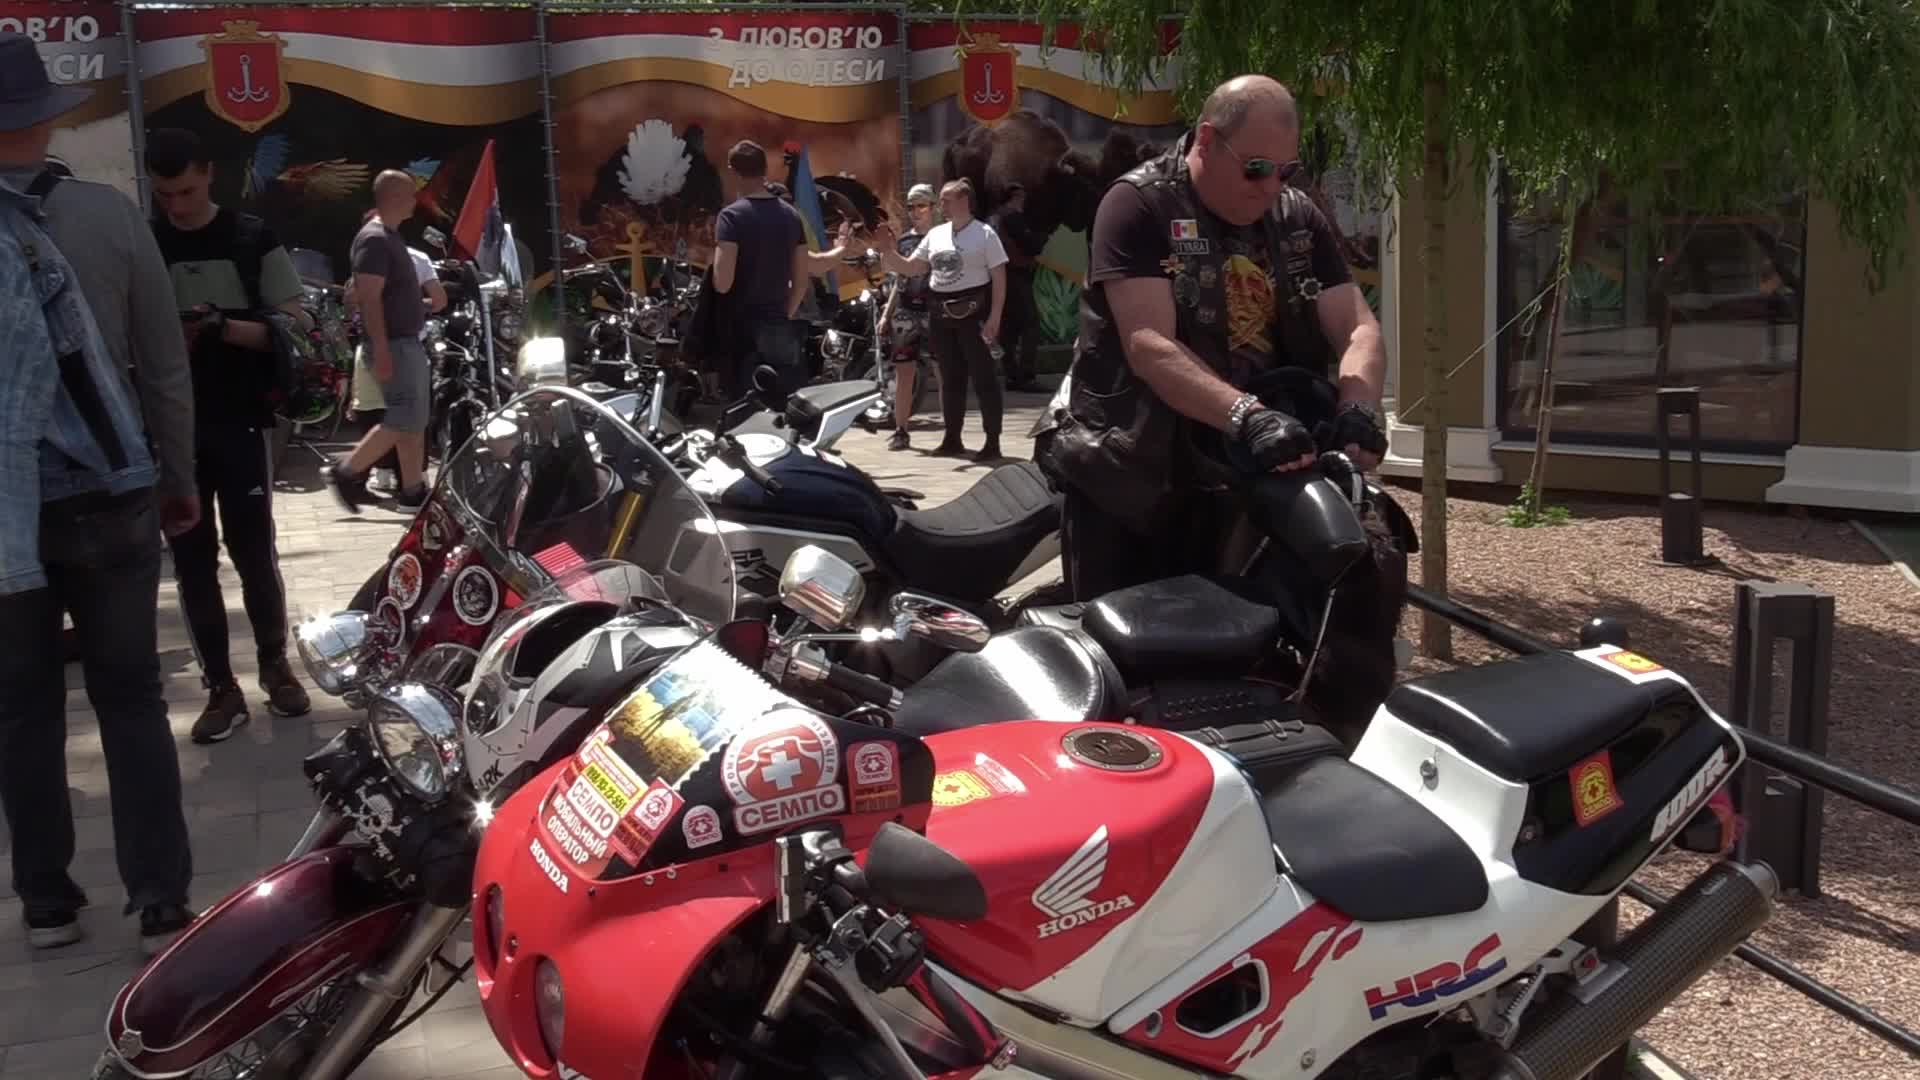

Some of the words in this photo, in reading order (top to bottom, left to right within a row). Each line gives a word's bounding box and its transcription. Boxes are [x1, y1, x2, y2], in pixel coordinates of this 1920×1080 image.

[0, 16, 98, 42] ОВ'Ю
[738, 26, 882, 49] ЛЮБОВ'Ю
[728, 58, 771, 88] ДО
[784, 58, 886, 87] ОДЕСИ
[552, 793, 609, 859] МОБИЛЬНЫЙ
[571, 781, 614, 831] СЕМПО
[741, 790, 839, 828] СЕМПО
[546, 815, 589, 865] ОПЕРАТОР
[529, 838, 570, 894] HONDA
[1037, 894, 1135, 938] HONDA
[1363, 932, 1507, 1021] HRC
